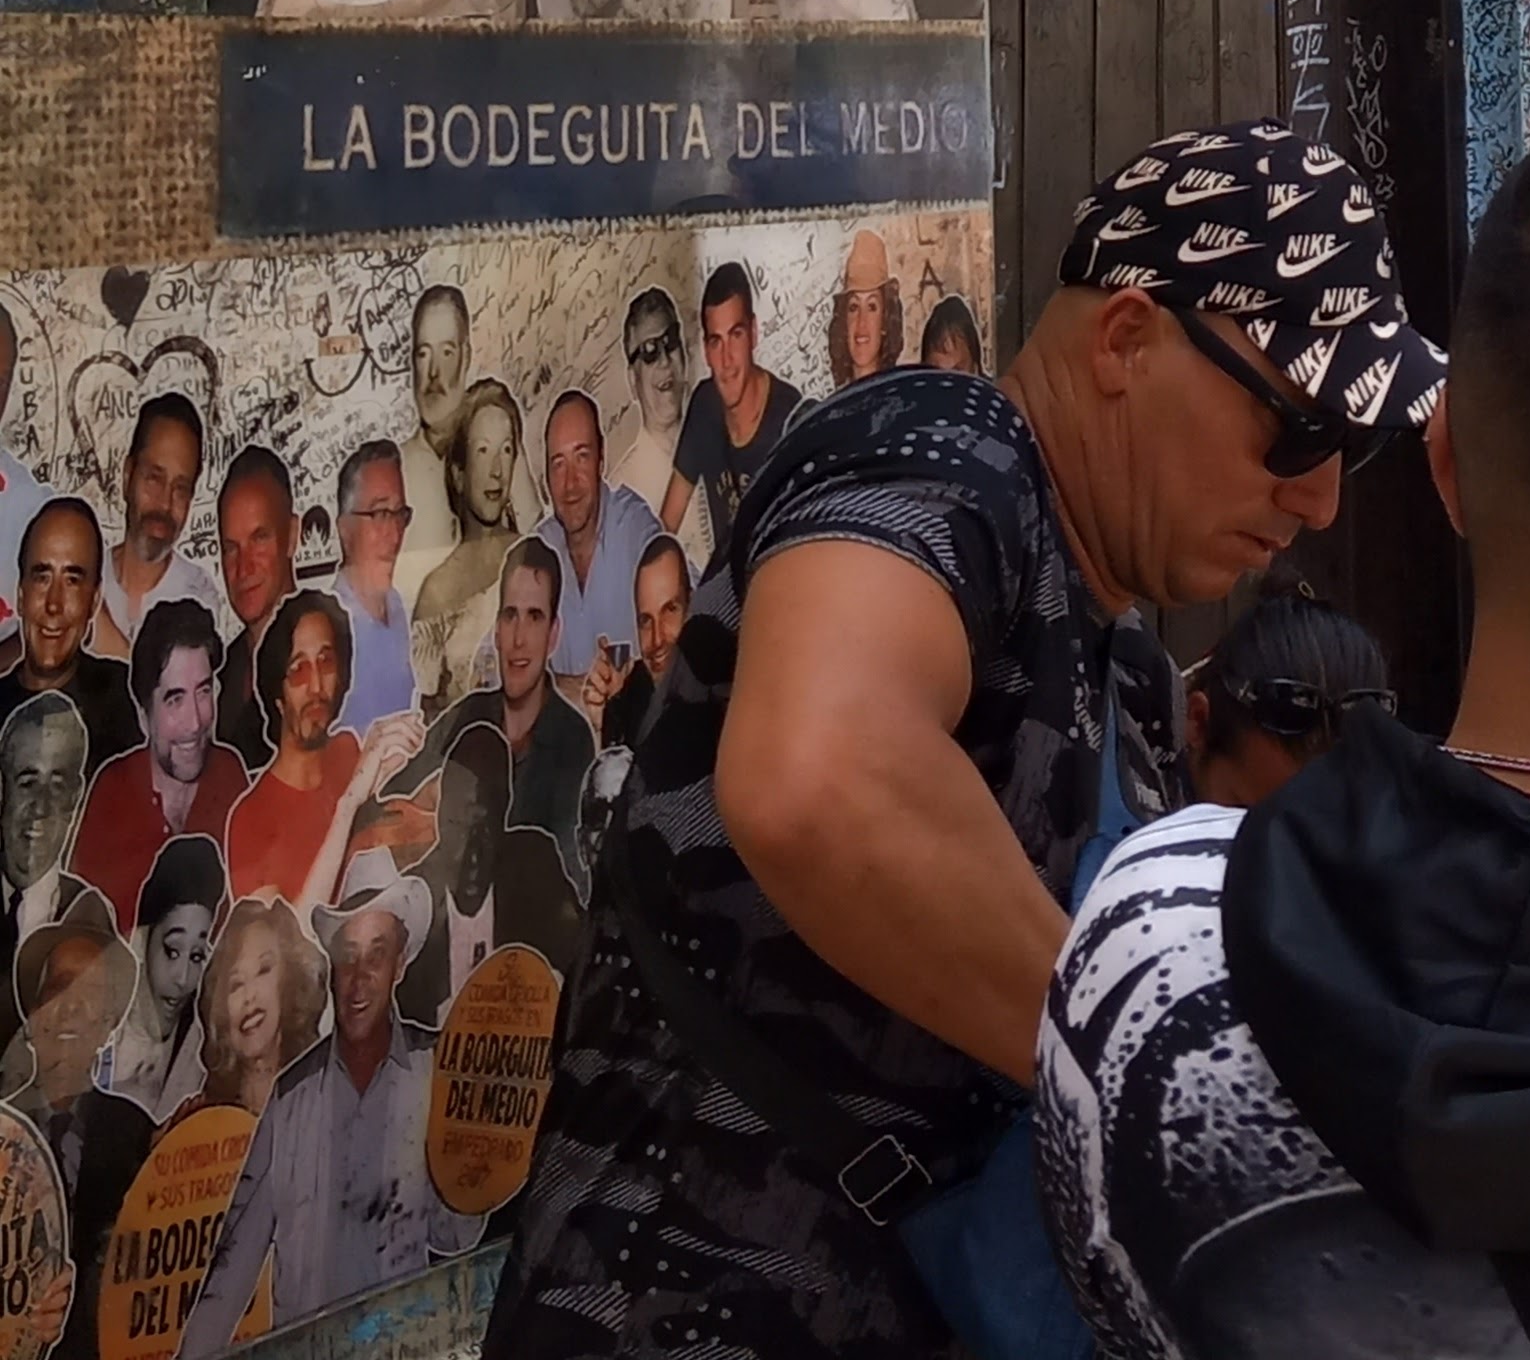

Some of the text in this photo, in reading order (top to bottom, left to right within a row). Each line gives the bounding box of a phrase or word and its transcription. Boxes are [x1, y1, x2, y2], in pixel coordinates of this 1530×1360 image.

[302, 100, 970, 172] LA BODEGUITA DEL MEDIO
[1179, 168, 1237, 190] NIKE
[1267, 183, 1301, 208] IKE
[1191, 222, 1250, 249] NIKE
[1285, 233, 1338, 258] NIKE
[1206, 281, 1266, 308] NIKE
[1320, 287, 1370, 313] NIKE
[1342, 357, 1392, 415] NIKE
[438, 1030, 462, 1073] LA
[444, 1079, 539, 1130] DEL MEDIO
[128, 1283, 171, 1340] DEL
